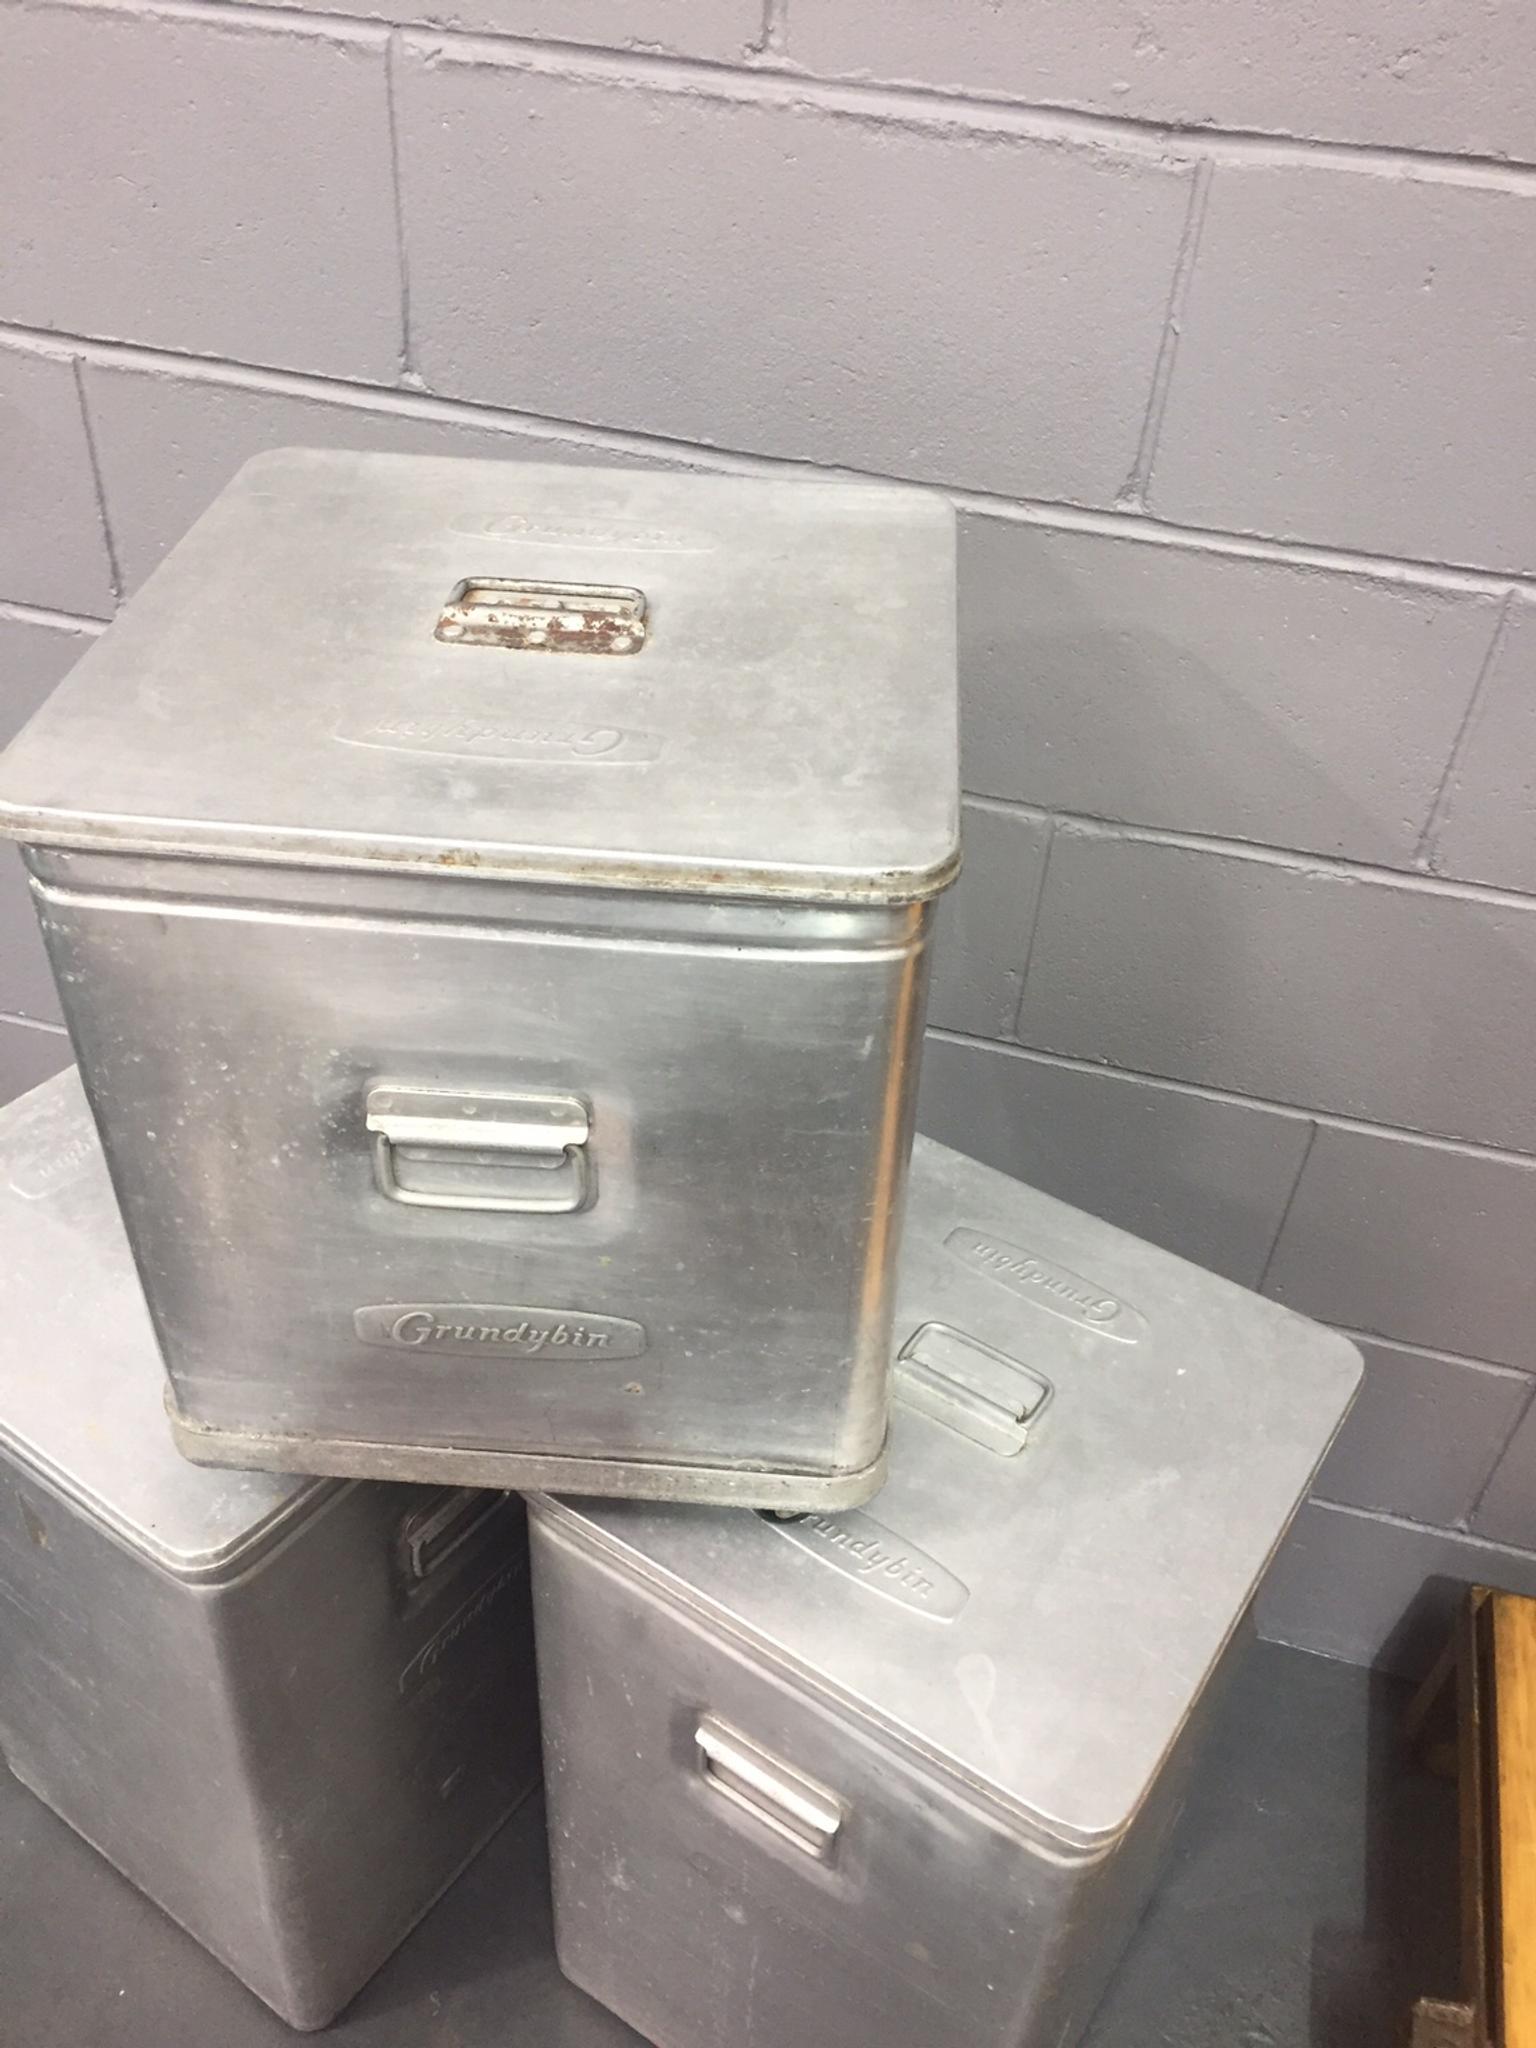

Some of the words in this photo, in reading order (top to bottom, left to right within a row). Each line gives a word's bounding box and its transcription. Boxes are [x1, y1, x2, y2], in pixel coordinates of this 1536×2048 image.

[974, 1242, 1122, 1324] Grundybin
[392, 1311, 609, 1353] Grundybin
[800, 1514, 935, 1599] rundybin
